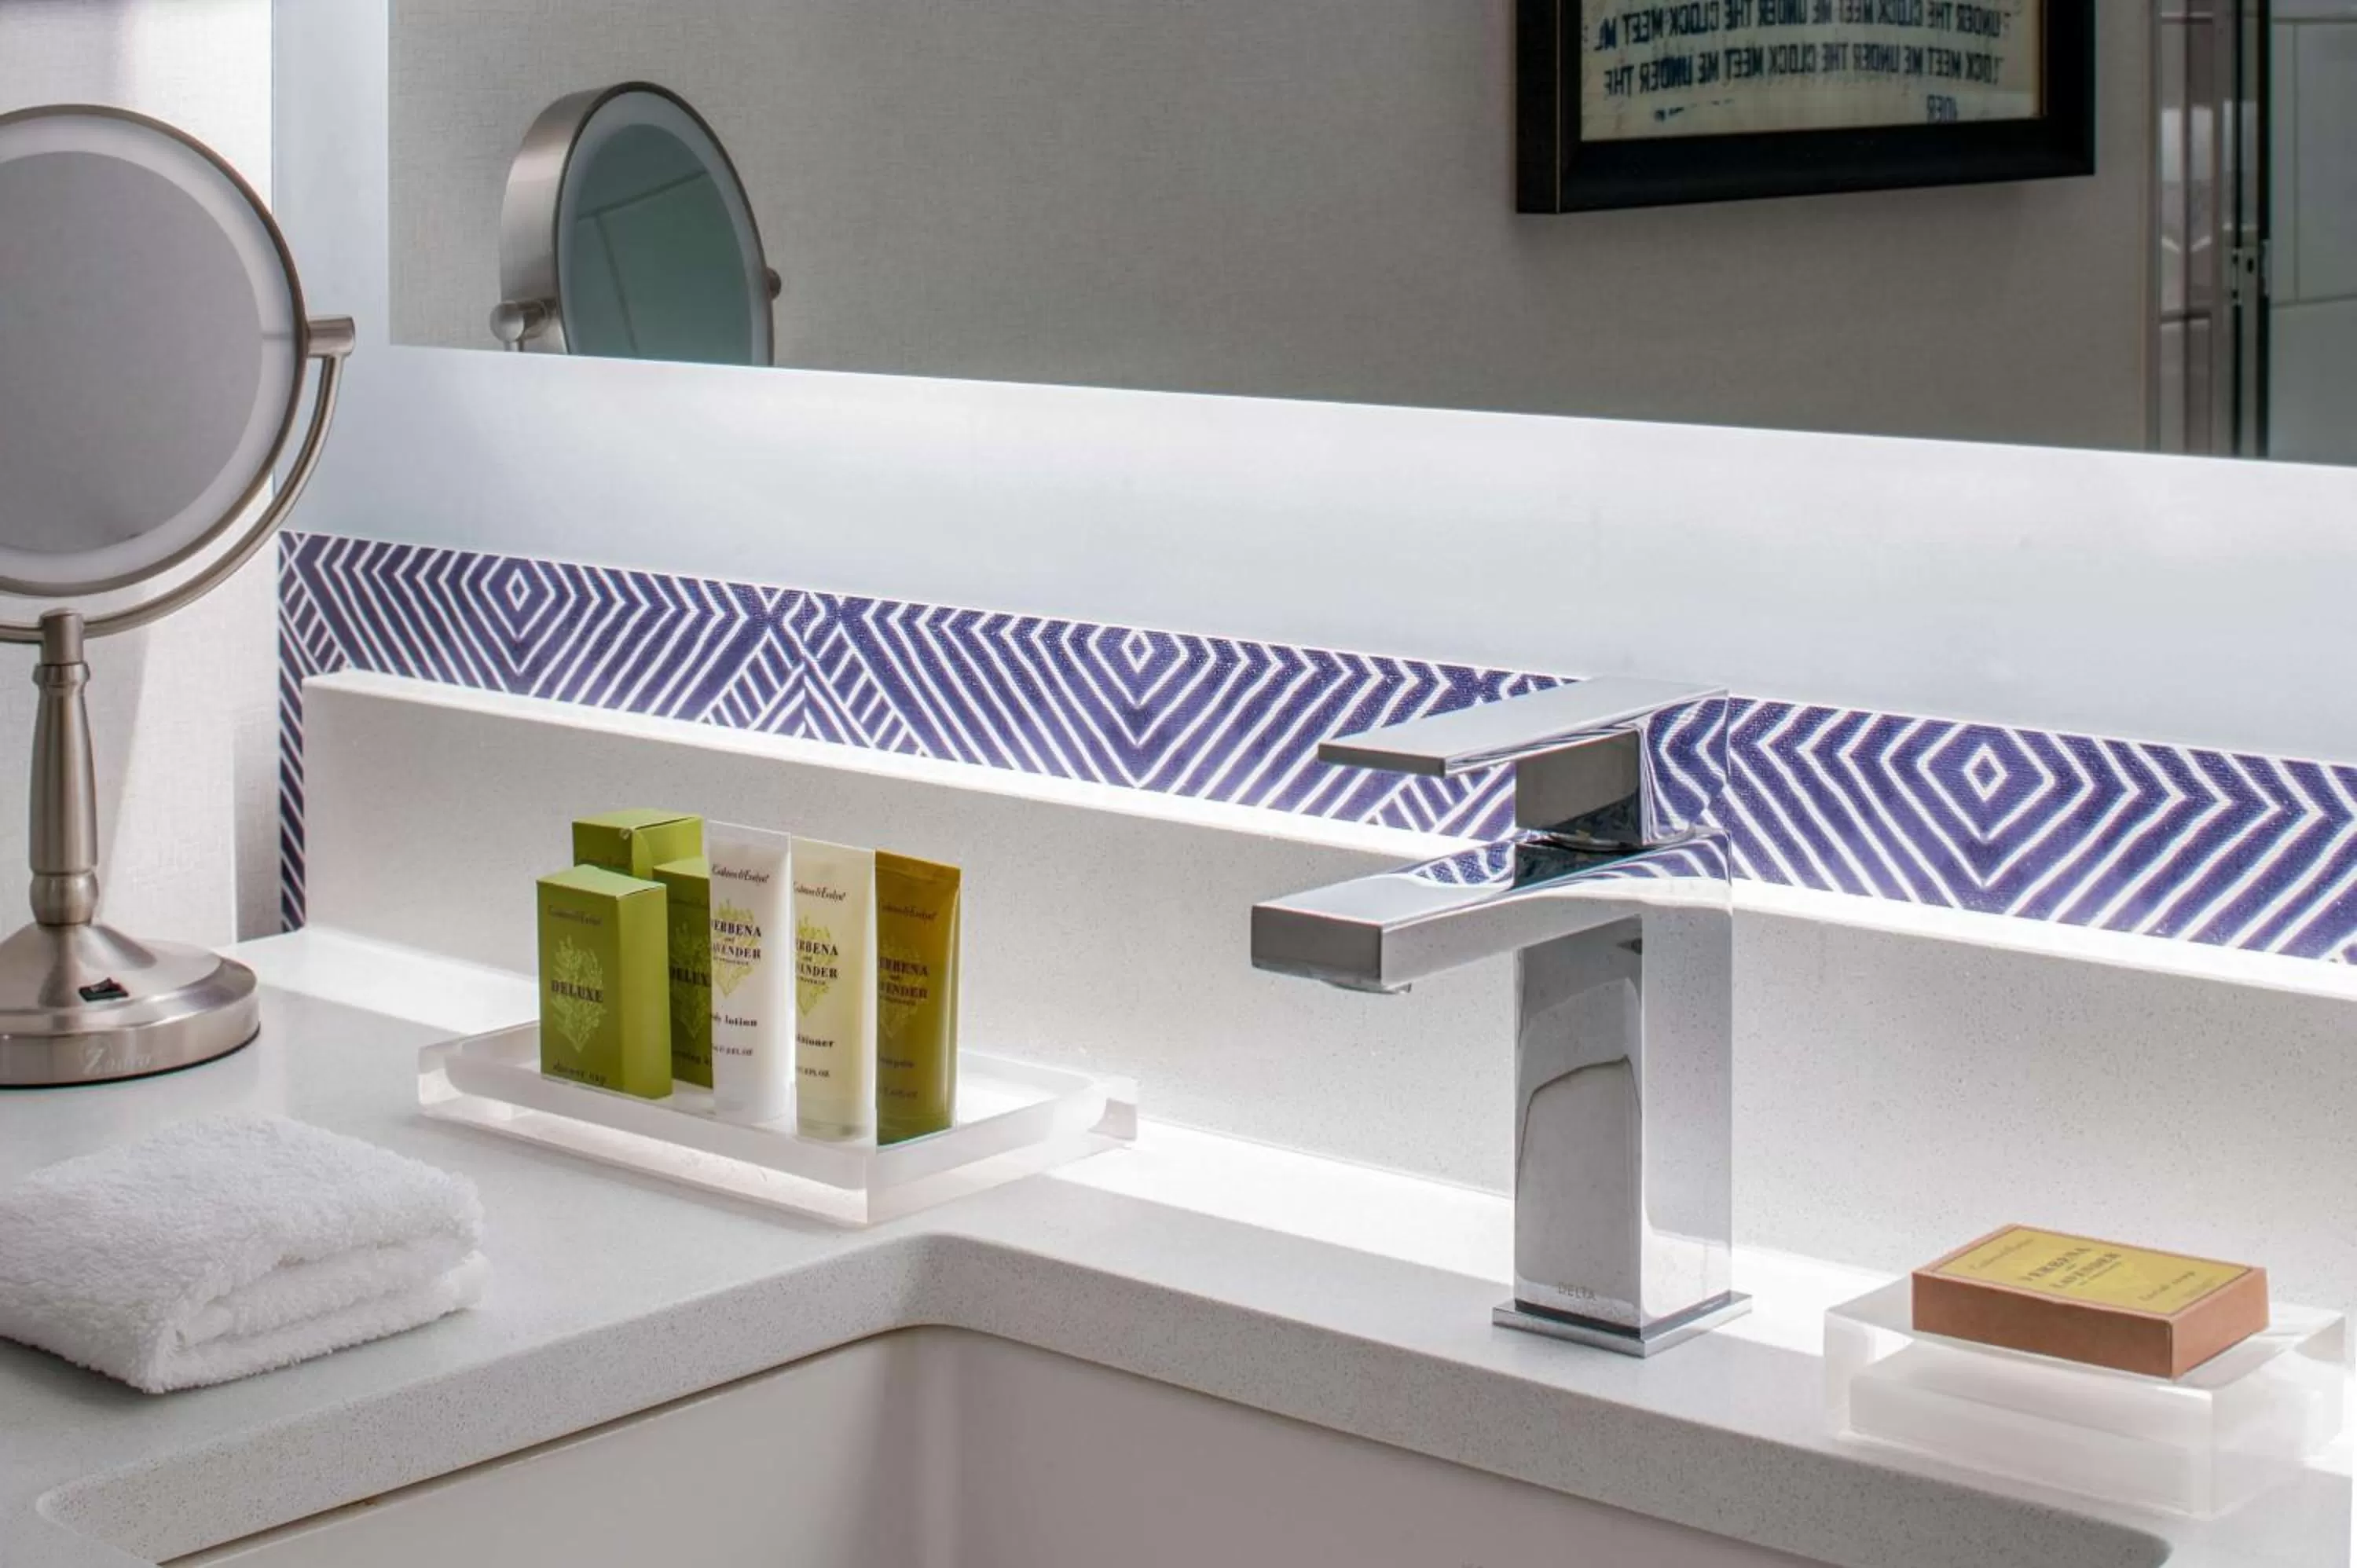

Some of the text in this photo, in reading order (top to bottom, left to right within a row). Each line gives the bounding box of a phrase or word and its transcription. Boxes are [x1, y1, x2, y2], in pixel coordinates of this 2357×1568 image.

[552, 980, 603, 1003] DELUXE
[725, 1014, 758, 1027] lotion
[1558, 1281, 1597, 1301] DELTA
